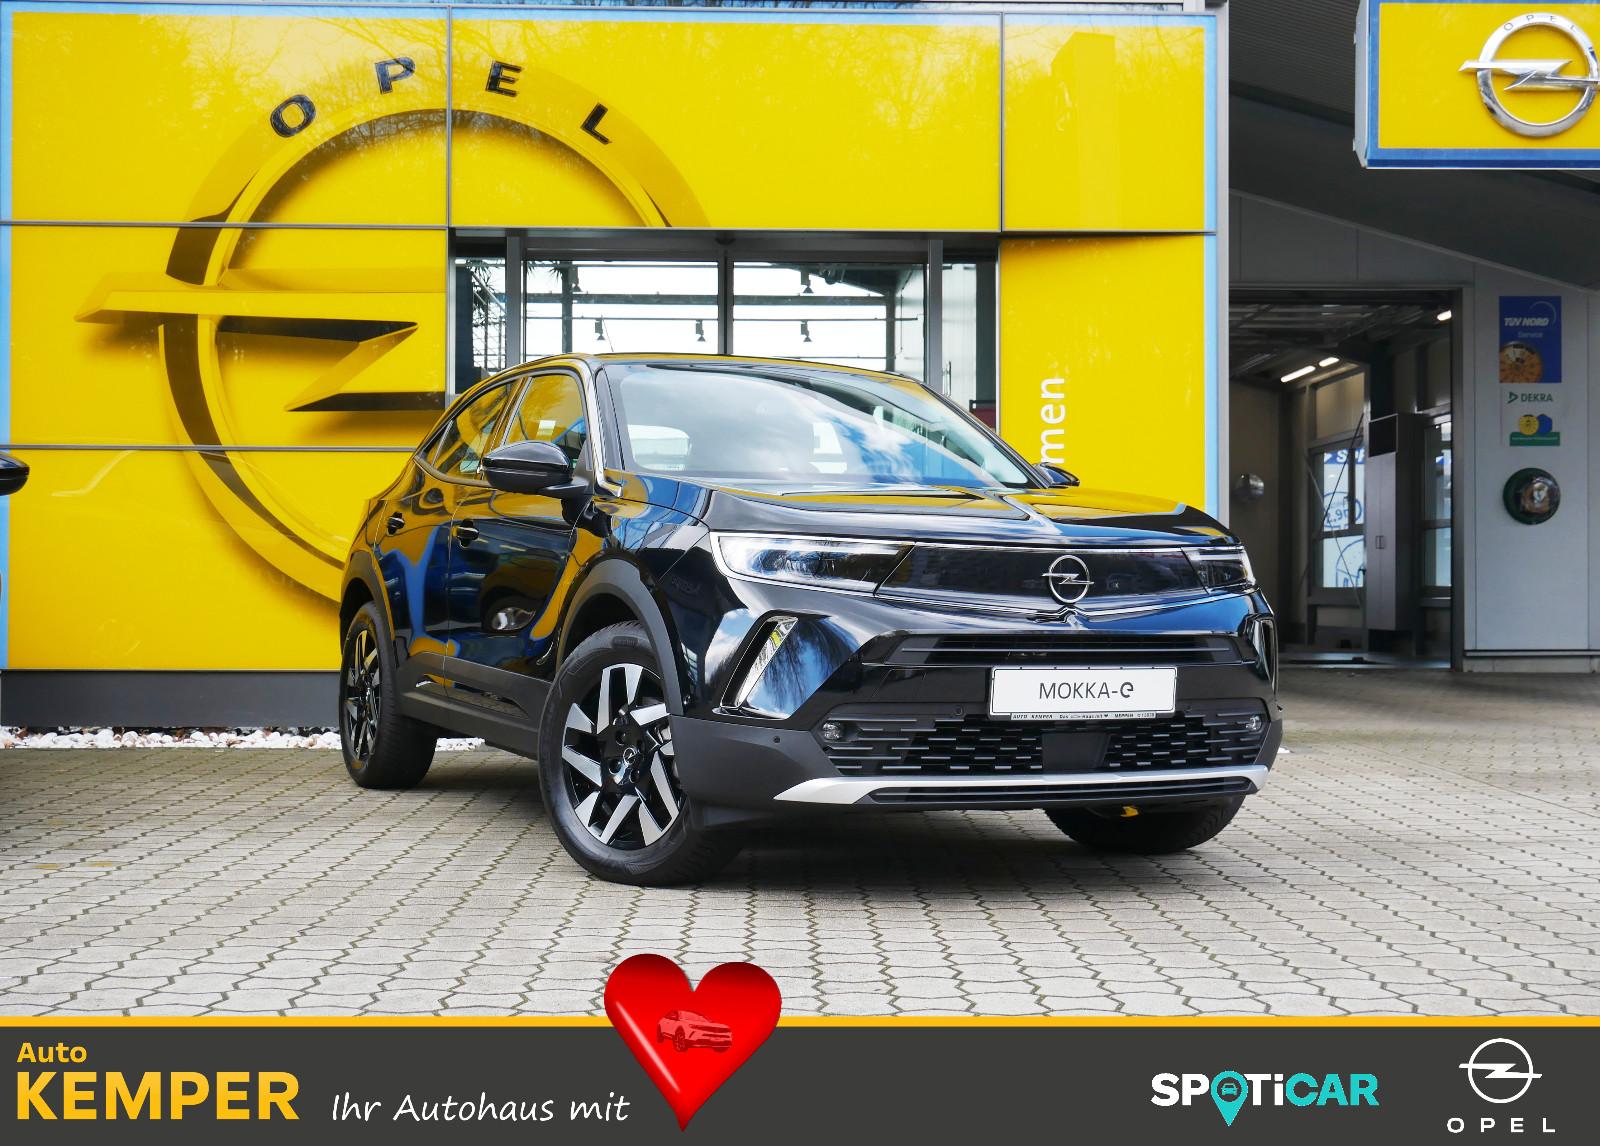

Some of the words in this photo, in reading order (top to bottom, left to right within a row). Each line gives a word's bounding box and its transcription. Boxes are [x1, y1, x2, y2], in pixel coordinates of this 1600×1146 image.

[1503, 14, 1578, 31] OPEL
[270, 56, 611, 145] OPEL
[1522, 317, 1550, 327] NORD
[1520, 393, 1553, 403] DEKRA
